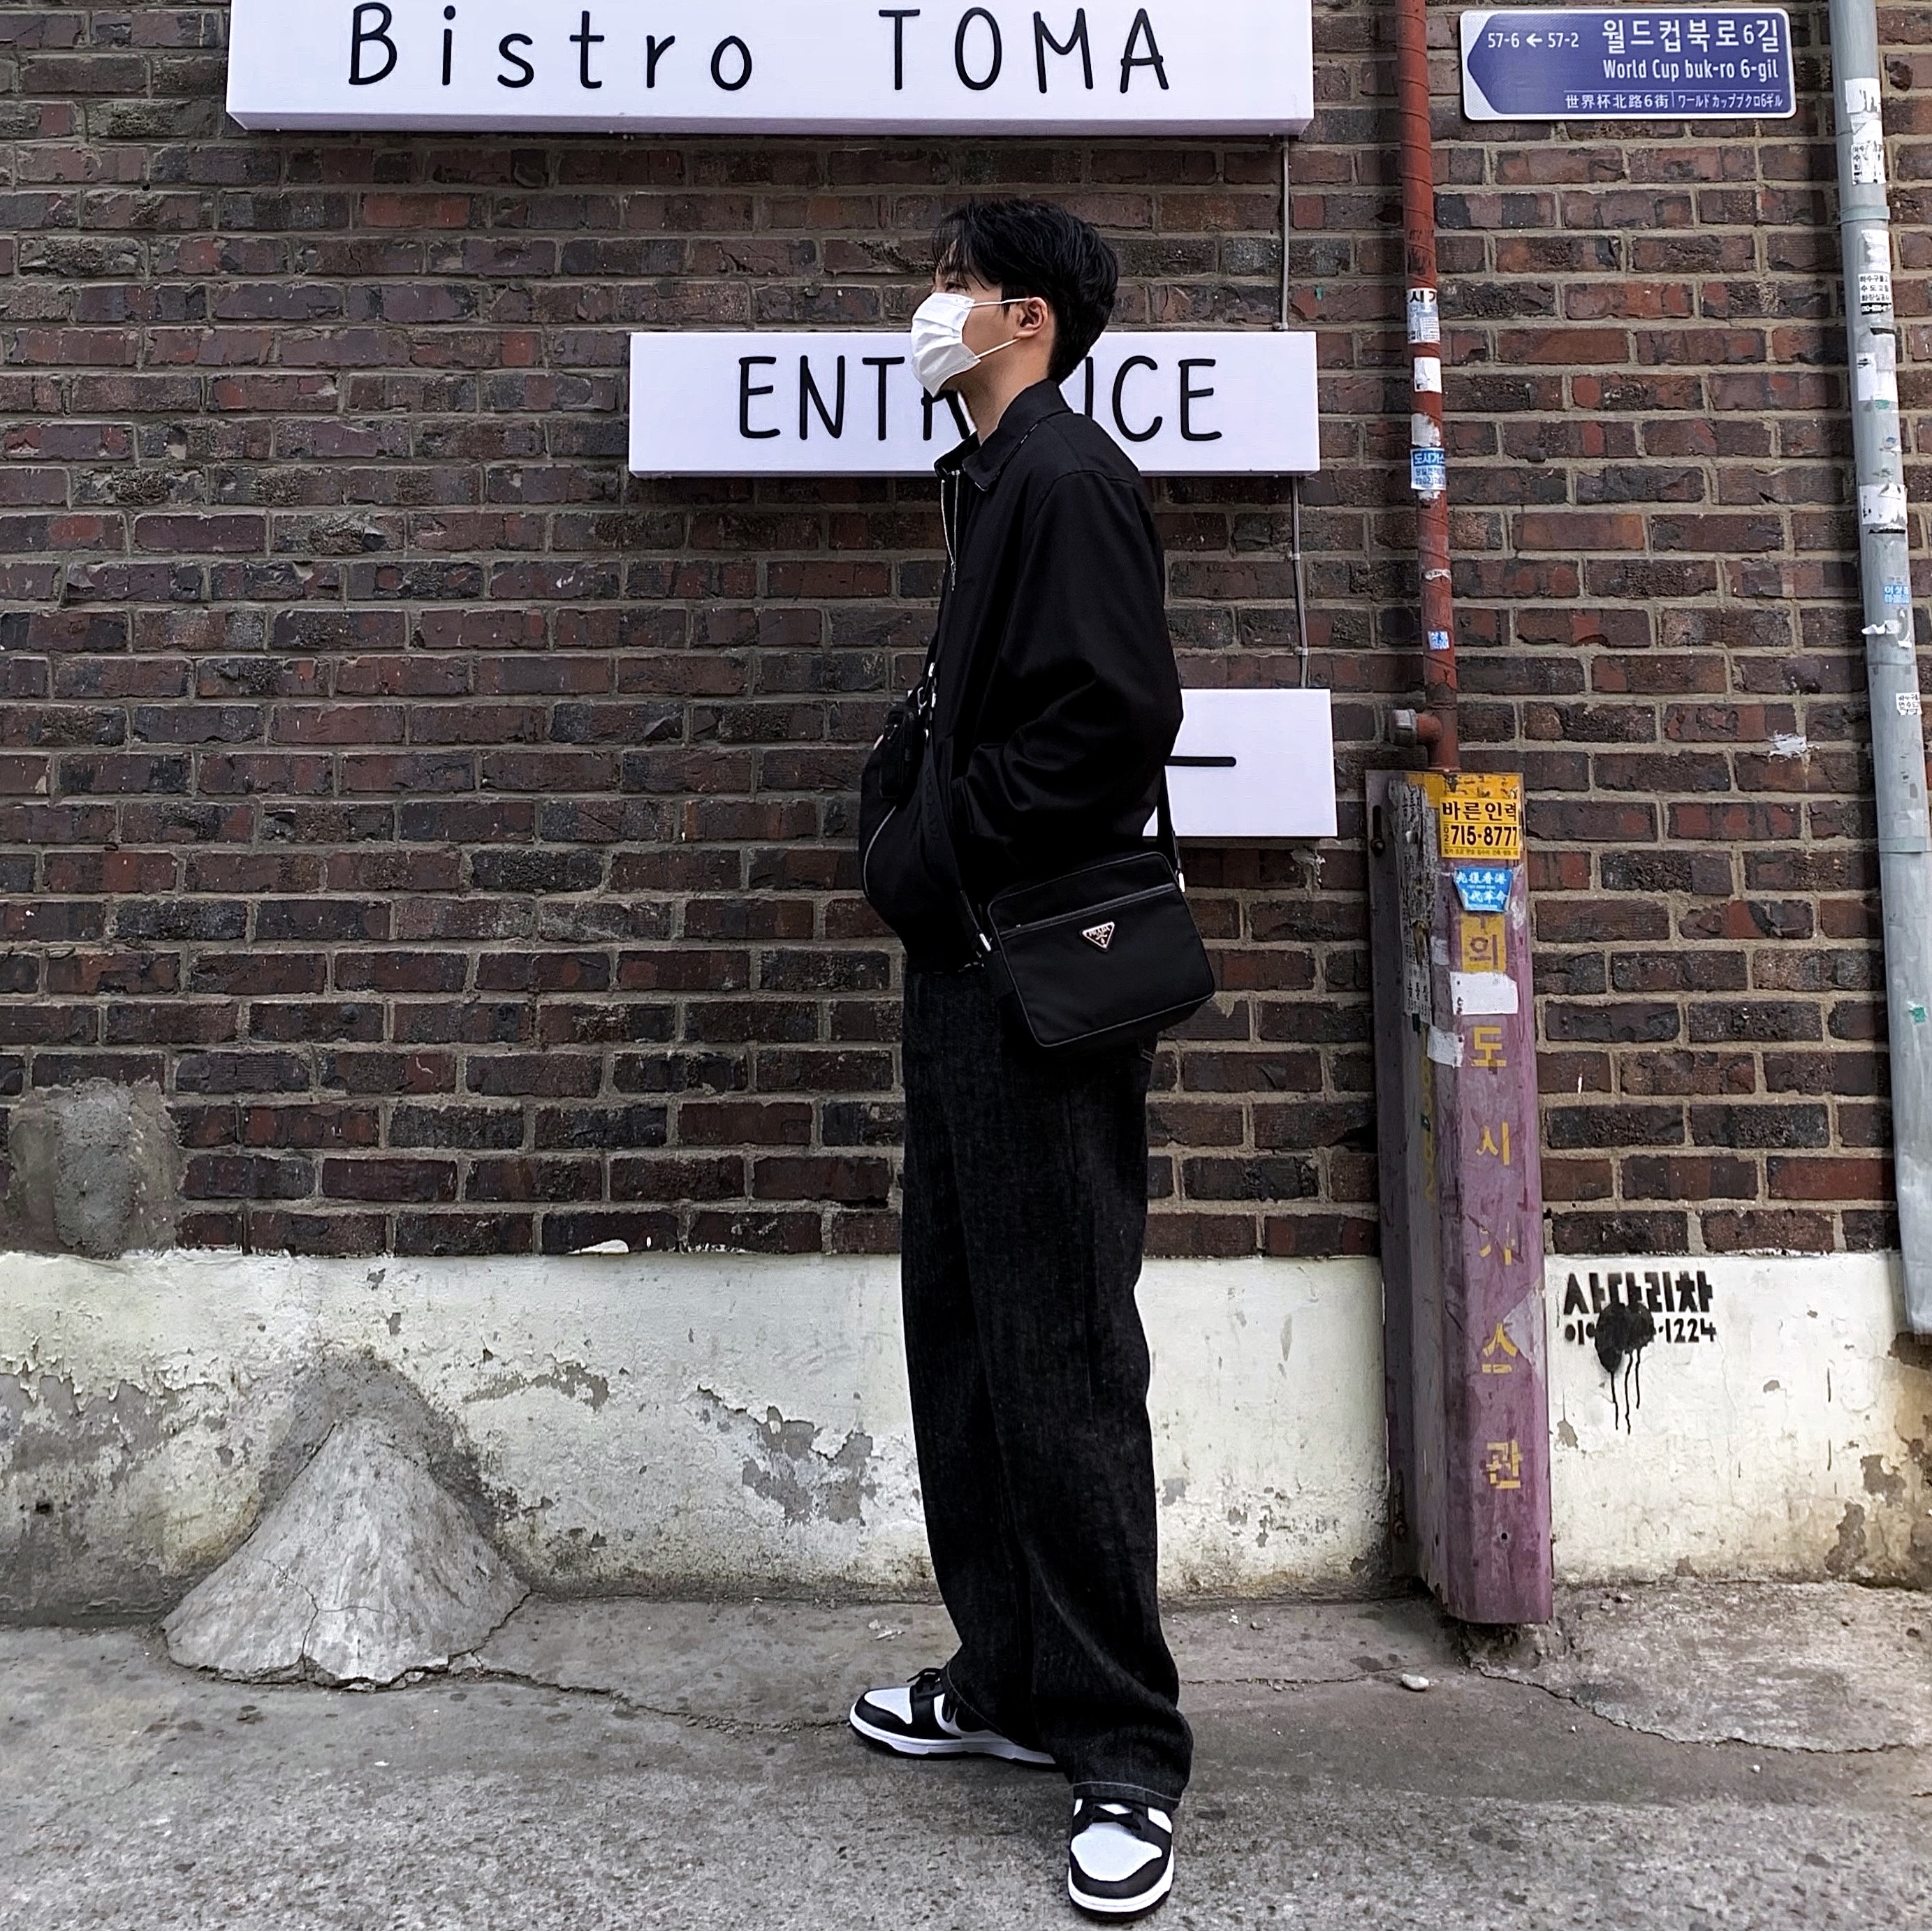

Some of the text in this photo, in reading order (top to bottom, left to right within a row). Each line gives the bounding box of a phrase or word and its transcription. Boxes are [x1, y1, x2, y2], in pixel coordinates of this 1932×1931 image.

[348, 1, 1169, 94] Bistro TOMA
[1488, 32, 1580, 48] 57-6 57-2
[1602, 19, 1780, 54] 월드컵북로6길
[1603, 59, 1779, 82] World Cup buk-ro 6-gil
[1565, 94, 1669, 109] 世界杯北路6街
[1442, 801, 1517, 822] 바른인력
